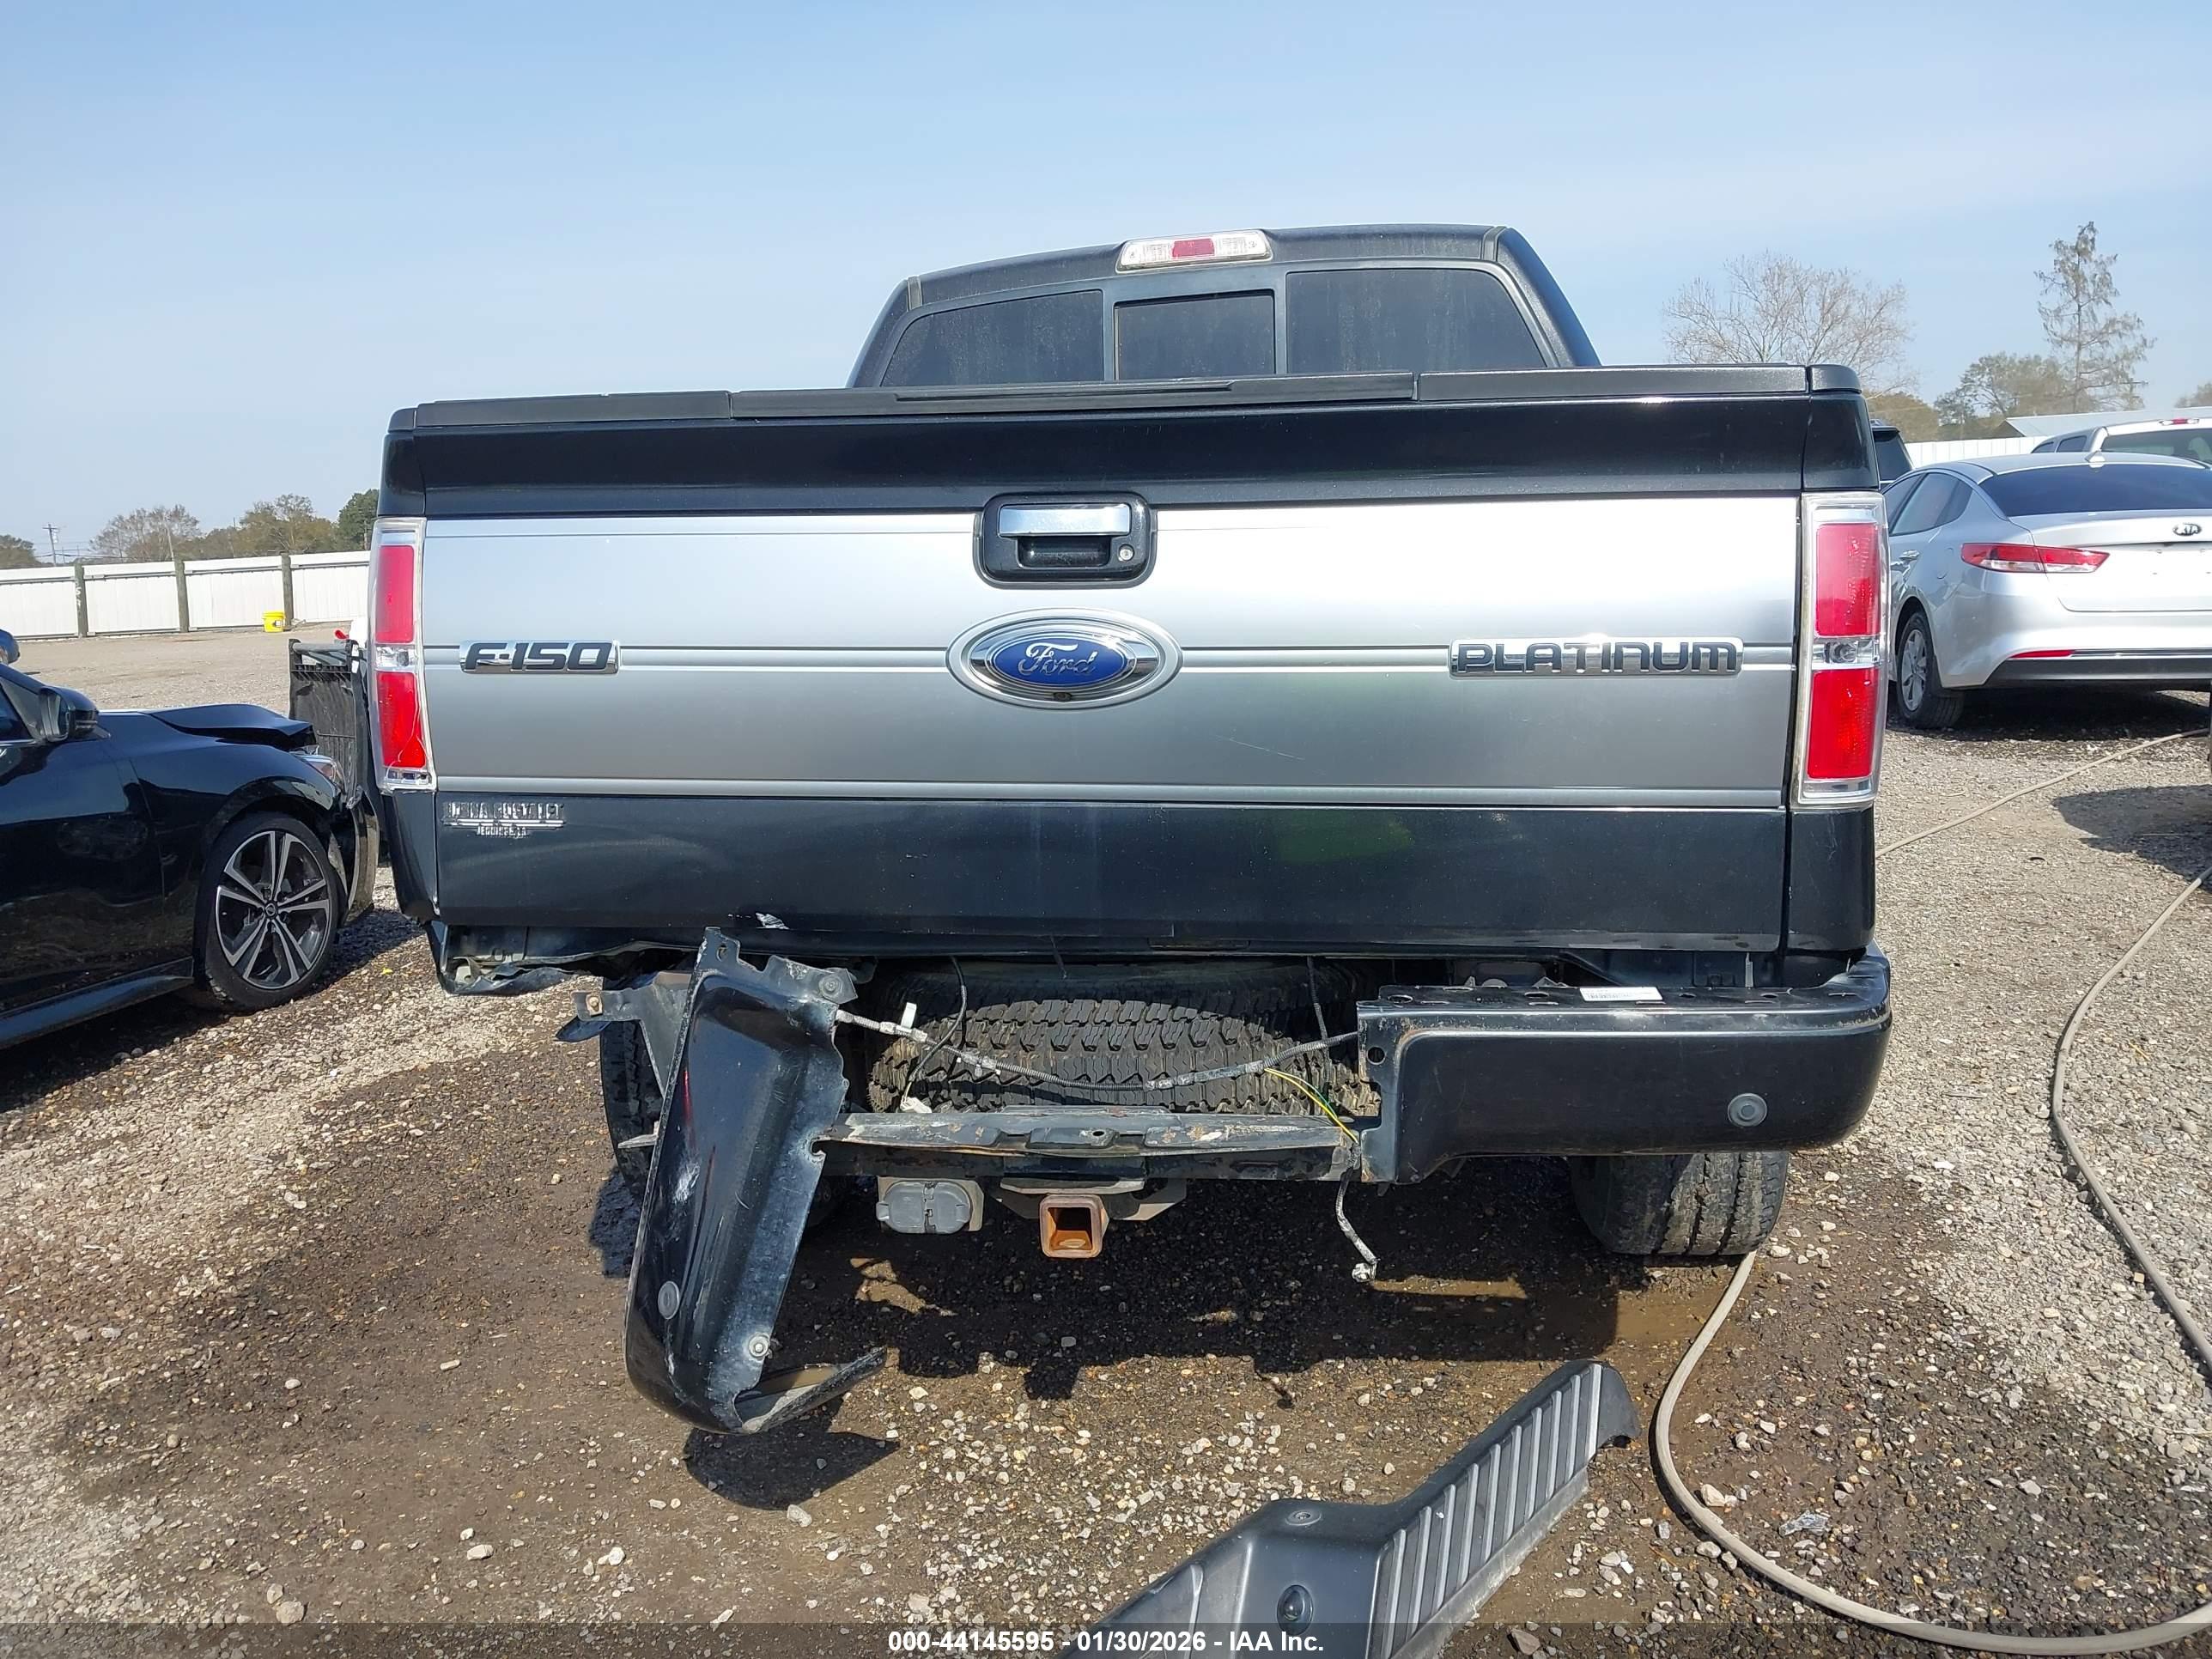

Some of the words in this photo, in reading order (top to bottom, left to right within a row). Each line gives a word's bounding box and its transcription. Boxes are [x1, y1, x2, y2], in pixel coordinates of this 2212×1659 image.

[465, 642, 612, 671] F-150
[1018, 642, 1098, 676] Ford
[1459, 641, 1738, 674] PLATINUM
